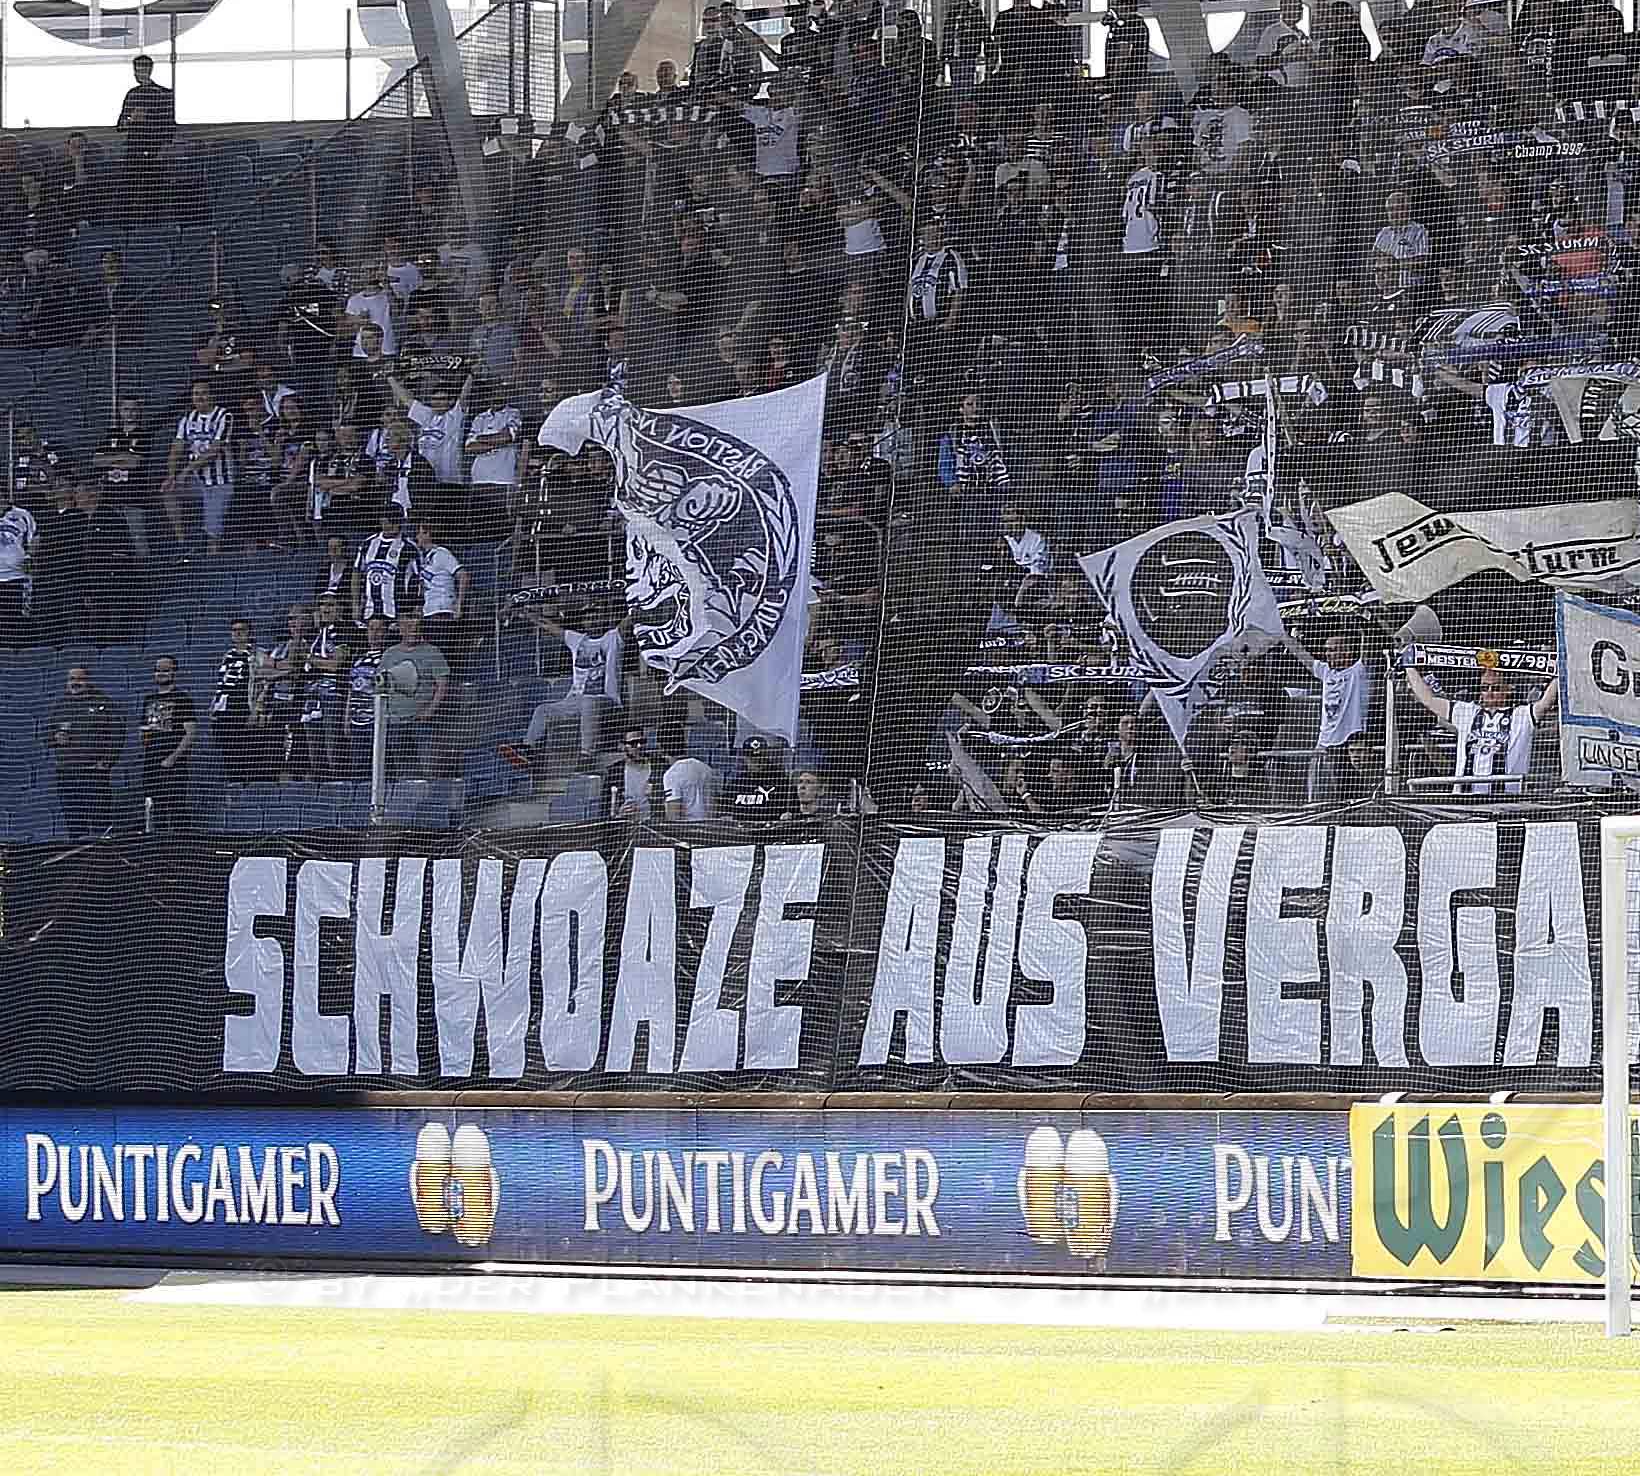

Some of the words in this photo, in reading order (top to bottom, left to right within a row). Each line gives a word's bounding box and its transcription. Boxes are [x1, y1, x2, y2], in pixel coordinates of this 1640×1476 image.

[1515, 142, 1552, 158] Champ
[1511, 540, 1620, 574] turm
[1427, 655, 1477, 668] MEISTER
[1499, 652, 1548, 669] 97/98
[221, 843, 824, 1076] SCHWOAZE
[859, 831, 1104, 1068] AUS
[26, 1132, 341, 1228] PUNTIGAMER
[581, 1136, 944, 1241] PUNTIGAMER
